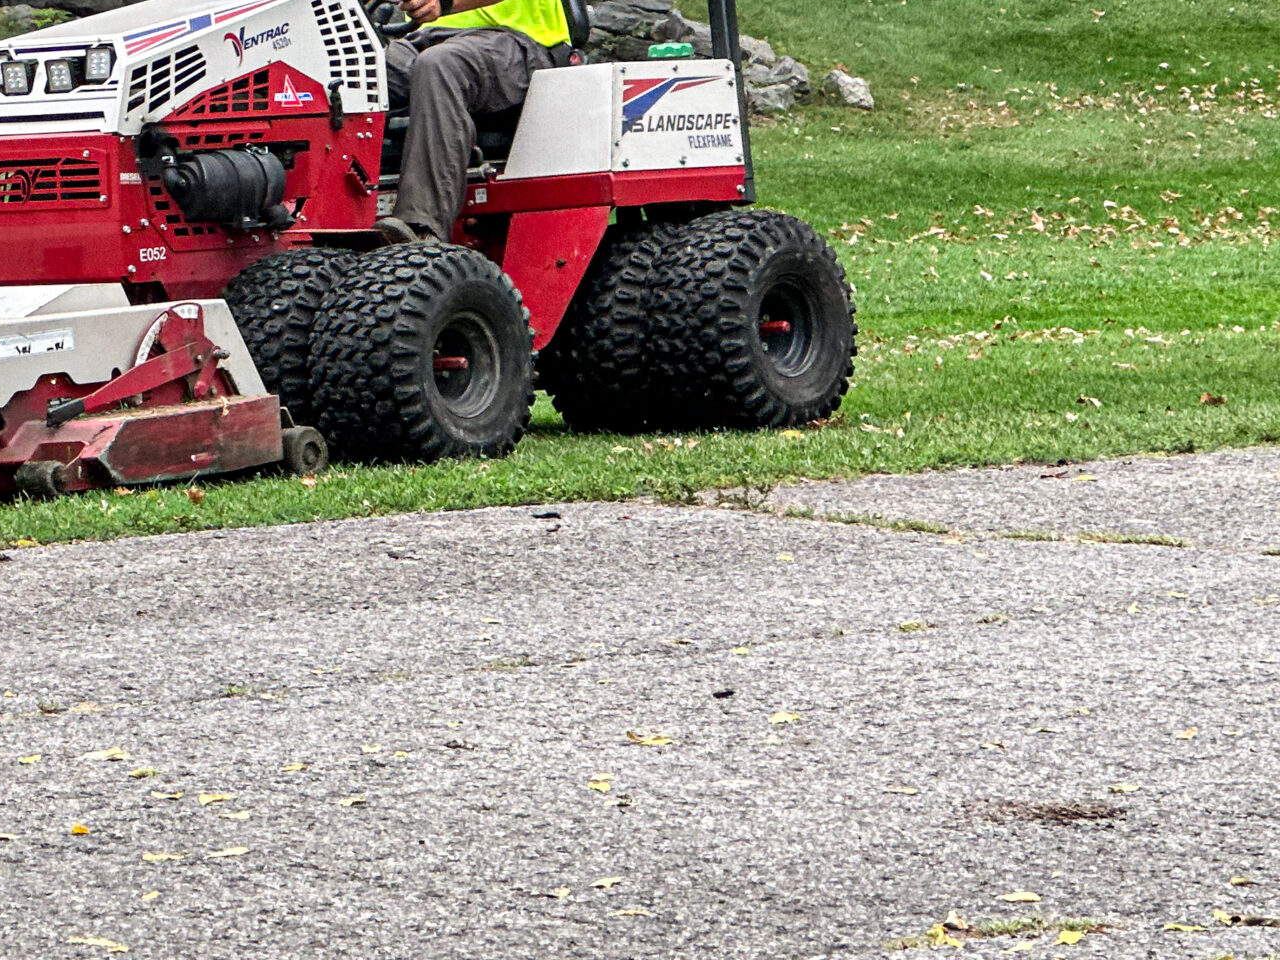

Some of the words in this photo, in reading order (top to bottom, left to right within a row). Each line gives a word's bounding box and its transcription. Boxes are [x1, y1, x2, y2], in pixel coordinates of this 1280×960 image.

[224, 22, 290, 67] VENTRAC
[647, 113, 732, 133] LANDSCAPE
[688, 134, 734, 149] FLEXFRAME
[140, 247, 167, 262] E052
